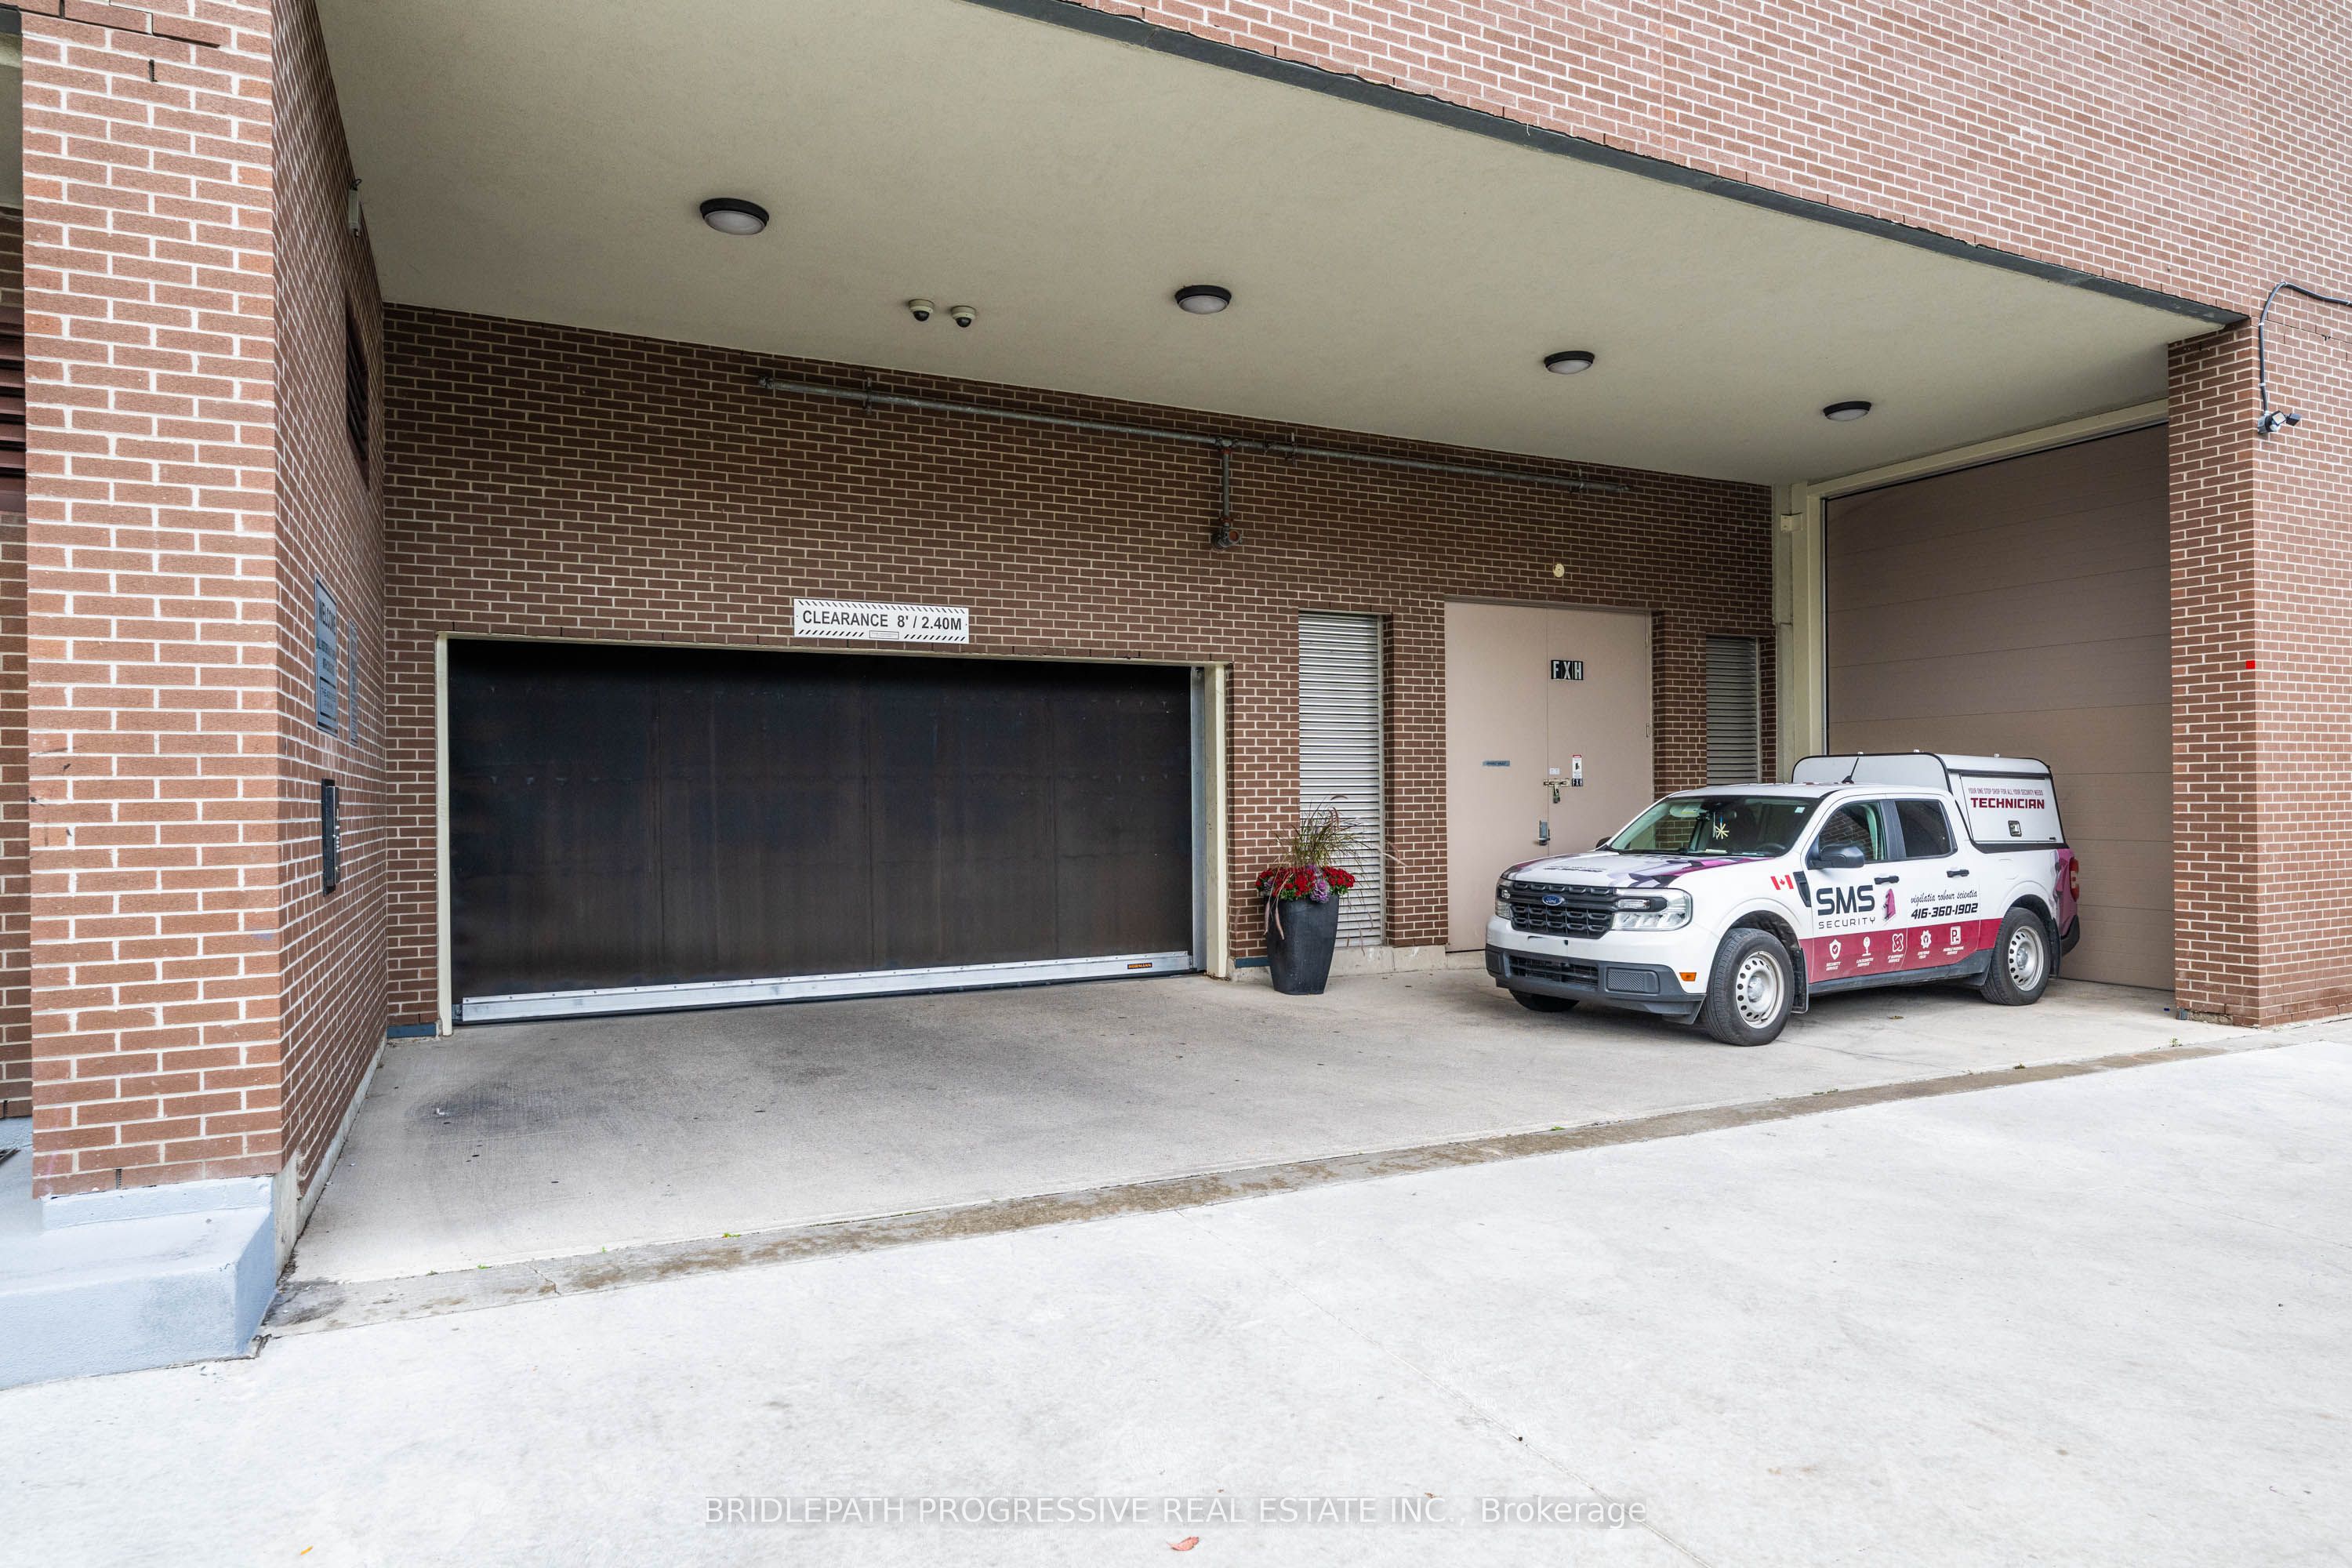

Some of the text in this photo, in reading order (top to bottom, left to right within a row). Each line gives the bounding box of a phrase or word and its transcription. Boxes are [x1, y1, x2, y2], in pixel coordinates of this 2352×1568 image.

[802, 609, 963, 630] CLEARANCE 8' / 2.40M
[1553, 660, 1583, 680] FXH
[1970, 797, 2045, 809] TECHNICIAN
[1816, 884, 1876, 916] SMS
[1957, 890, 1977, 899] scientia
[1911, 902, 1979, 920] 416-360-1902
[1818, 916, 1876, 929] SECURITY
